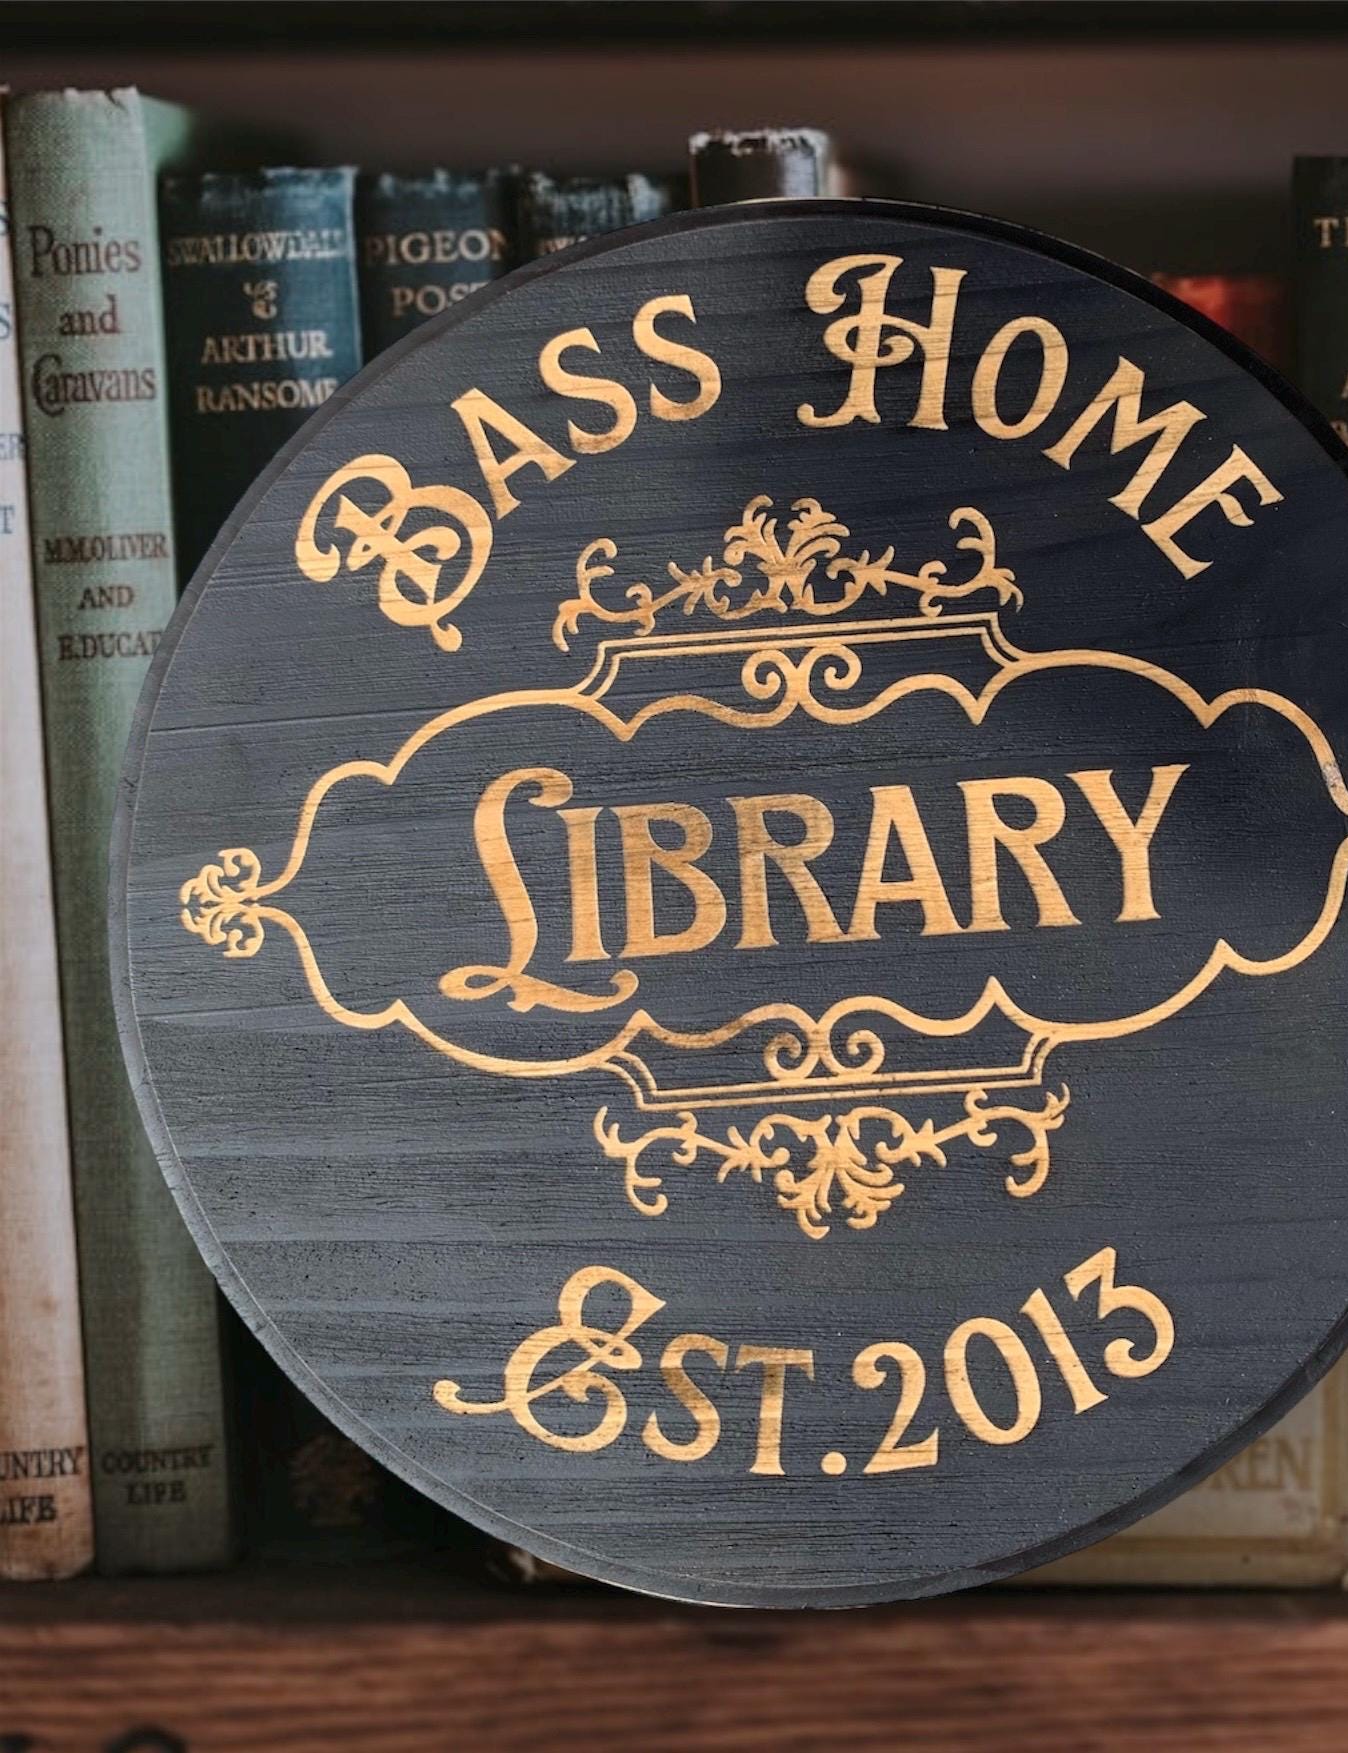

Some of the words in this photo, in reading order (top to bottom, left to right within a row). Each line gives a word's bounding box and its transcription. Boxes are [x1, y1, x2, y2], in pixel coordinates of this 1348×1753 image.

[30, 226, 142, 278] Ponies
[58, 295, 120, 338] and
[201, 330, 335, 365] ARTHUR
[32, 354, 157, 417] Caravans
[294, 293, 724, 653] BASS
[796, 253, 1284, 581] HOME
[77, 584, 135, 611] AND
[437, 763, 1192, 1013] LIBRARY
[0, 1446, 84, 1480] UNTRY
[101, 1443, 215, 1475] COUNTRY
[126, 1479, 188, 1505] LIFE
